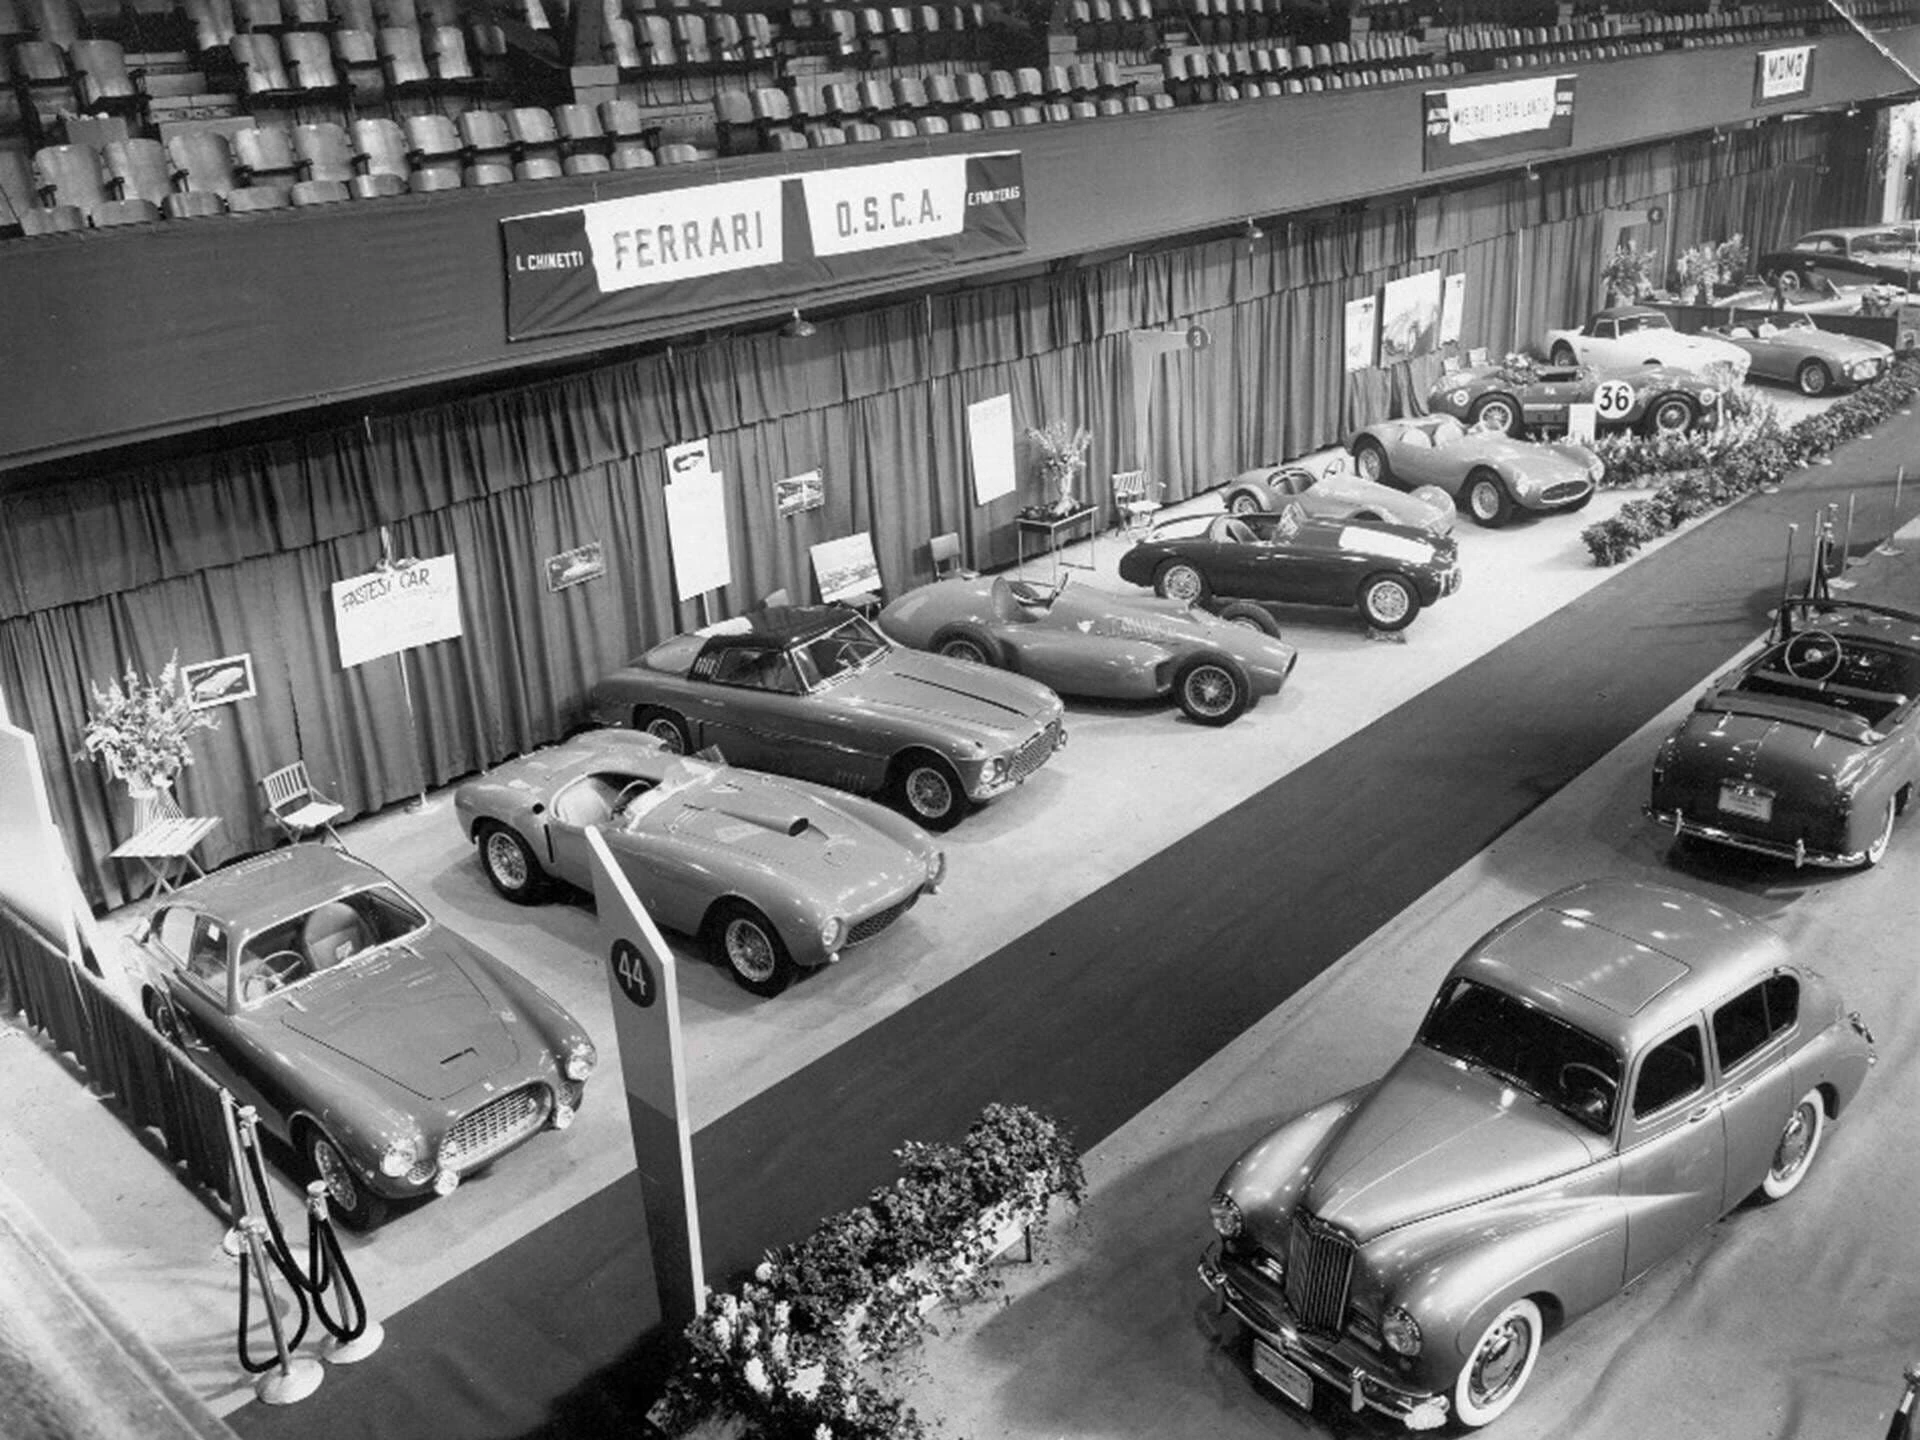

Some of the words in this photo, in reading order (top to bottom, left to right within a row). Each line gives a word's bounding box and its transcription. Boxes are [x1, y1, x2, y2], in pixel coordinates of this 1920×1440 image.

[612, 210, 765, 271] FERRARI
[528, 251, 584, 271] CHINETTI
[1600, 386, 1629, 411] 36
[399, 568, 430, 588] CAR
[619, 951, 646, 996] 44
